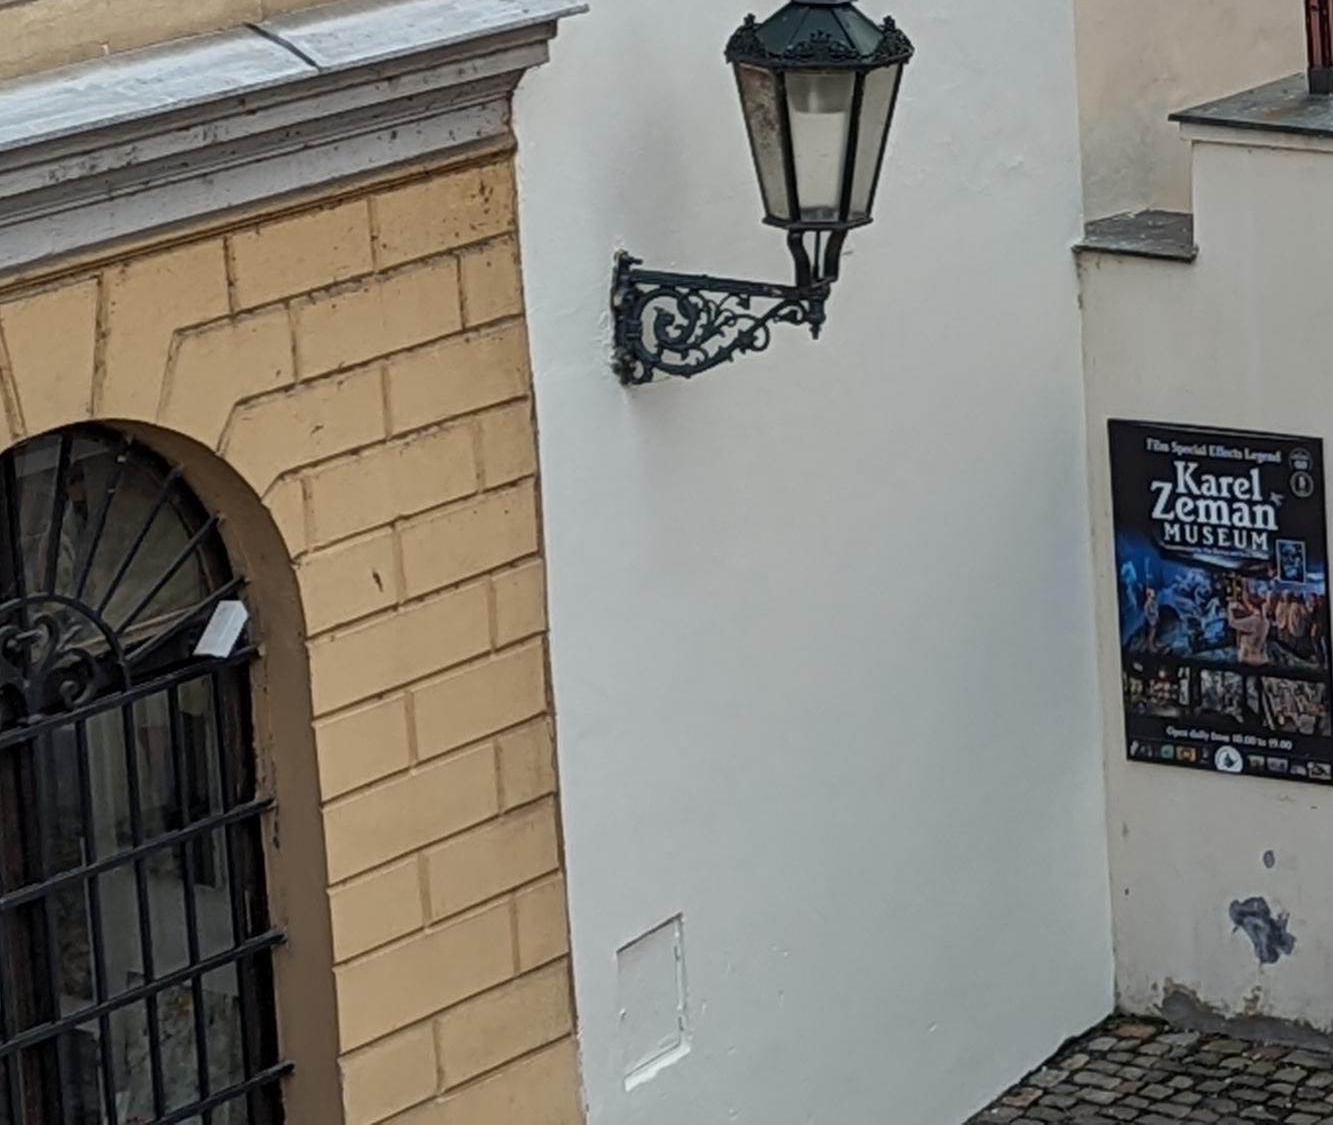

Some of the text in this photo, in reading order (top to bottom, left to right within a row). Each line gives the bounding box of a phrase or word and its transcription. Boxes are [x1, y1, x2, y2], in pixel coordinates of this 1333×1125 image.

[1147, 437, 1169, 452] Film
[1172, 442, 1207, 456] Special
[1209, 446, 1243, 459] Effects
[1245, 448, 1281, 464] Legend
[1174, 460, 1262, 501] Karel
[1151, 481, 1278, 531] Zeman
[1164, 522, 1268, 551] MUSEUM
